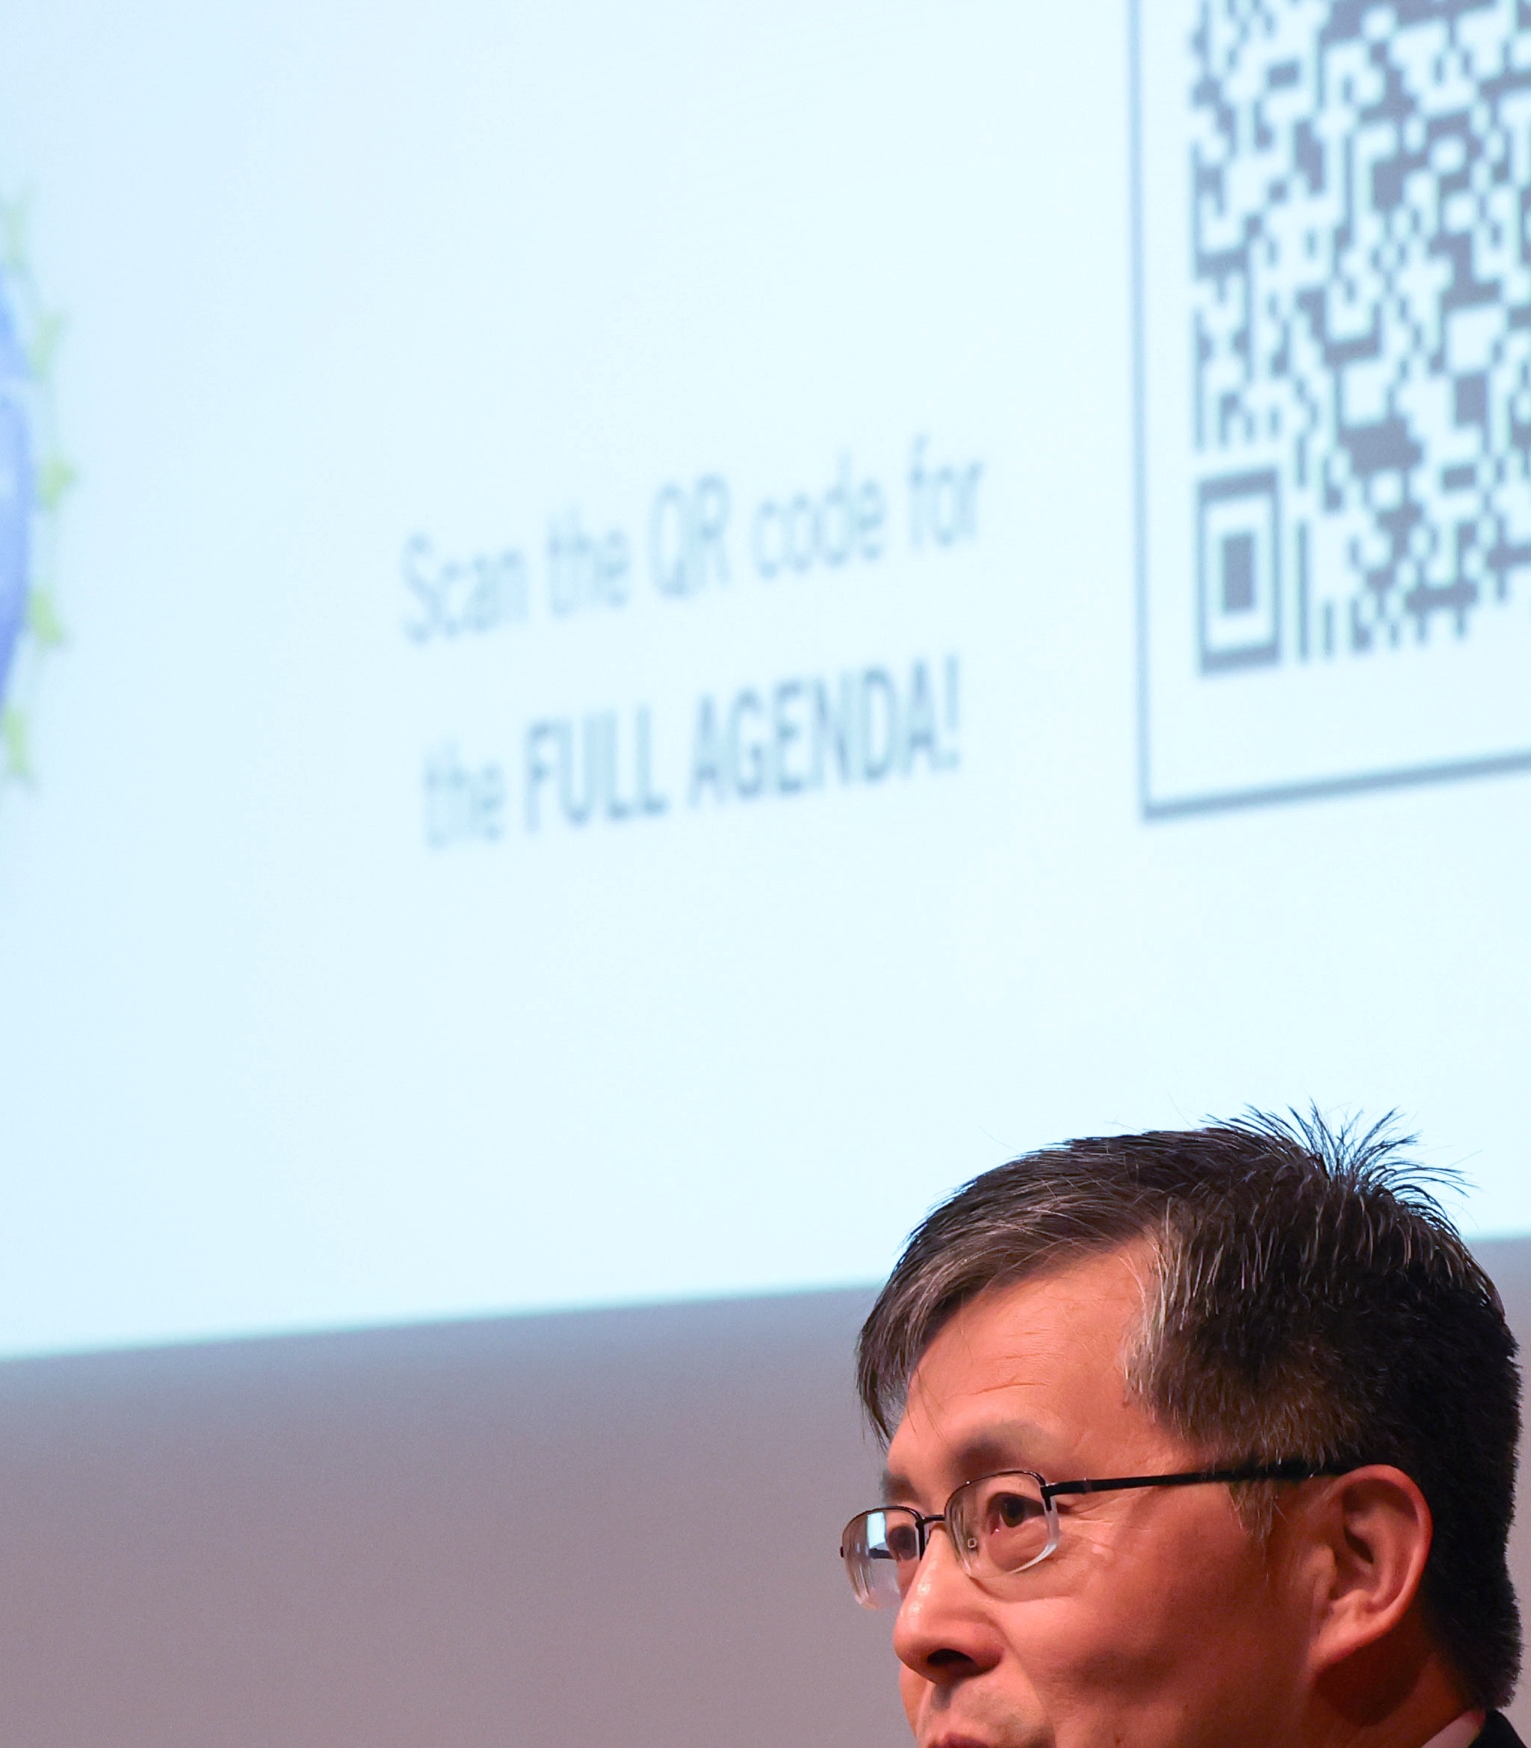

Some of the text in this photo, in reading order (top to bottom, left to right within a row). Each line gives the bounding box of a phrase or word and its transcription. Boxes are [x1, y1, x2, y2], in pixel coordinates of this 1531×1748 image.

[401, 432, 985, 647] Scan the QR code for
[423, 650, 961, 852] the FULL AGENDA!
